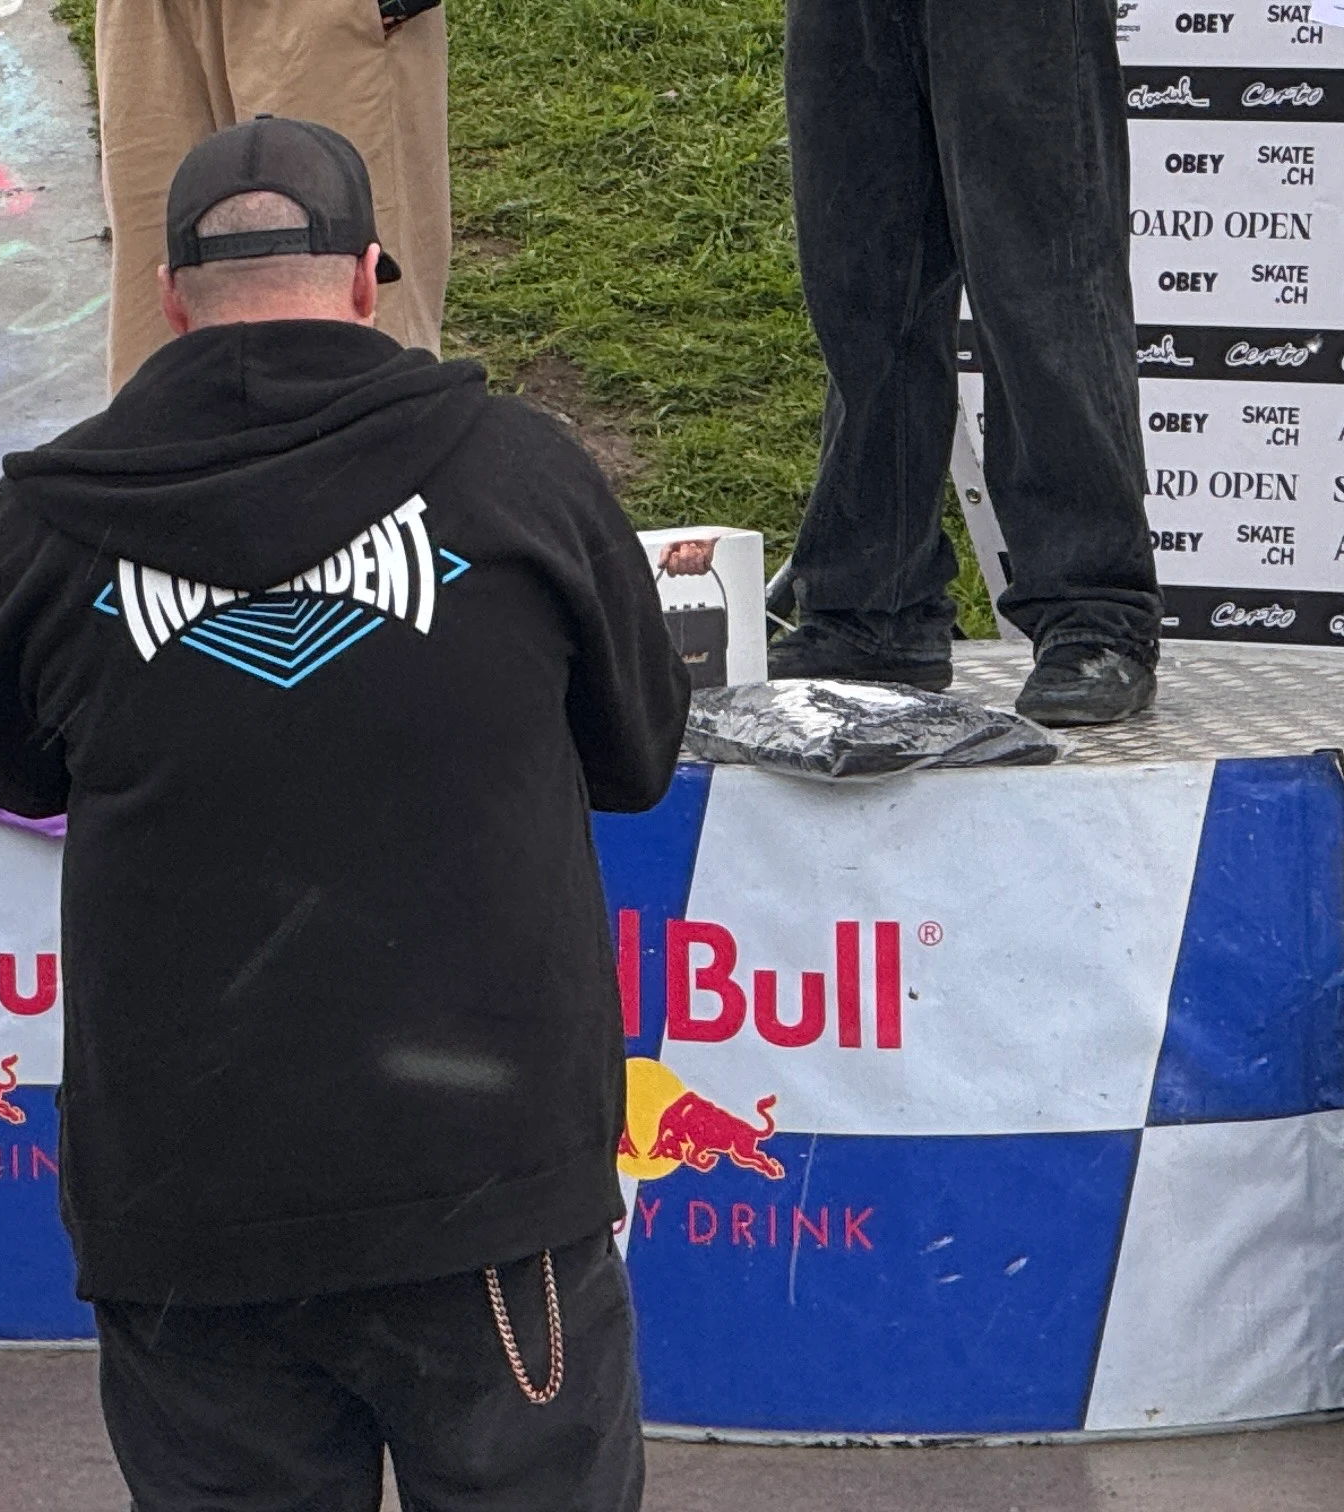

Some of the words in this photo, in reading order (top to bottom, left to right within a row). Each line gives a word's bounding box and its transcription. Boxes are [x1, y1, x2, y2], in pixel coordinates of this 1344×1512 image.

[1176, 13, 1234, 33] OBEY
[1241, 82, 1324, 107] Certo
[1165, 153, 1225, 174] OBEY
[1257, 146, 1315, 165] SKATE
[1281, 167, 1313, 185] .CH
[1225, 212, 1313, 240] OPEN
[1158, 271, 1218, 292] OBEY
[1251, 264, 1309, 283] SKATE
[1275, 285, 1307, 304] .CH
[1149, 412, 1208, 433] OBEY
[1242, 405, 1300, 424] SKATE
[1266, 428, 1299, 446] .CH
[1209, 471, 1298, 501] OPEN
[1237, 525, 1294, 544] SKATE
[1261, 547, 1294, 566] .CH
[1211, 602, 1296, 629] Certo
[666, 918, 903, 1049] Bull
[689, 1200, 875, 1251] DRINK
